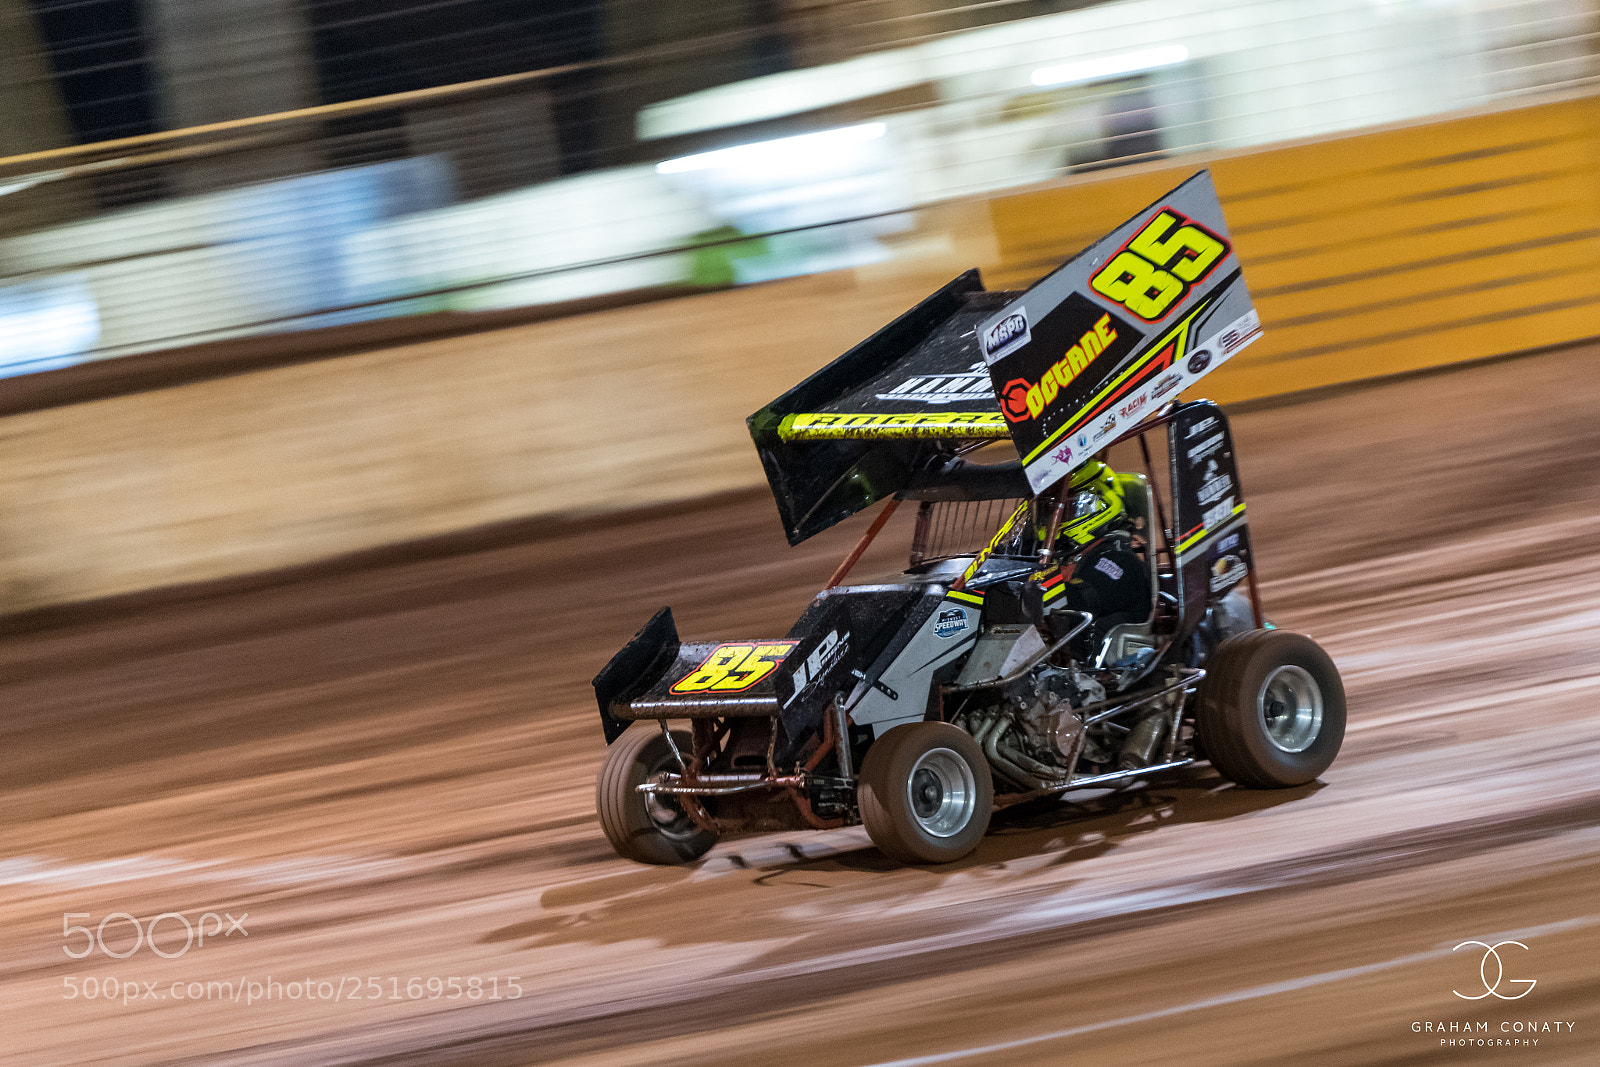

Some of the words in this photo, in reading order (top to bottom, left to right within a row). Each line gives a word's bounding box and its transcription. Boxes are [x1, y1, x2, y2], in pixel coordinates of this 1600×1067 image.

[1090, 207, 1231, 322] 85
[888, 376, 996, 394] HAMM
[934, 618, 968, 632] SPEEDWAY
[671, 642, 797, 693] 85
[783, 629, 839, 710] JP
